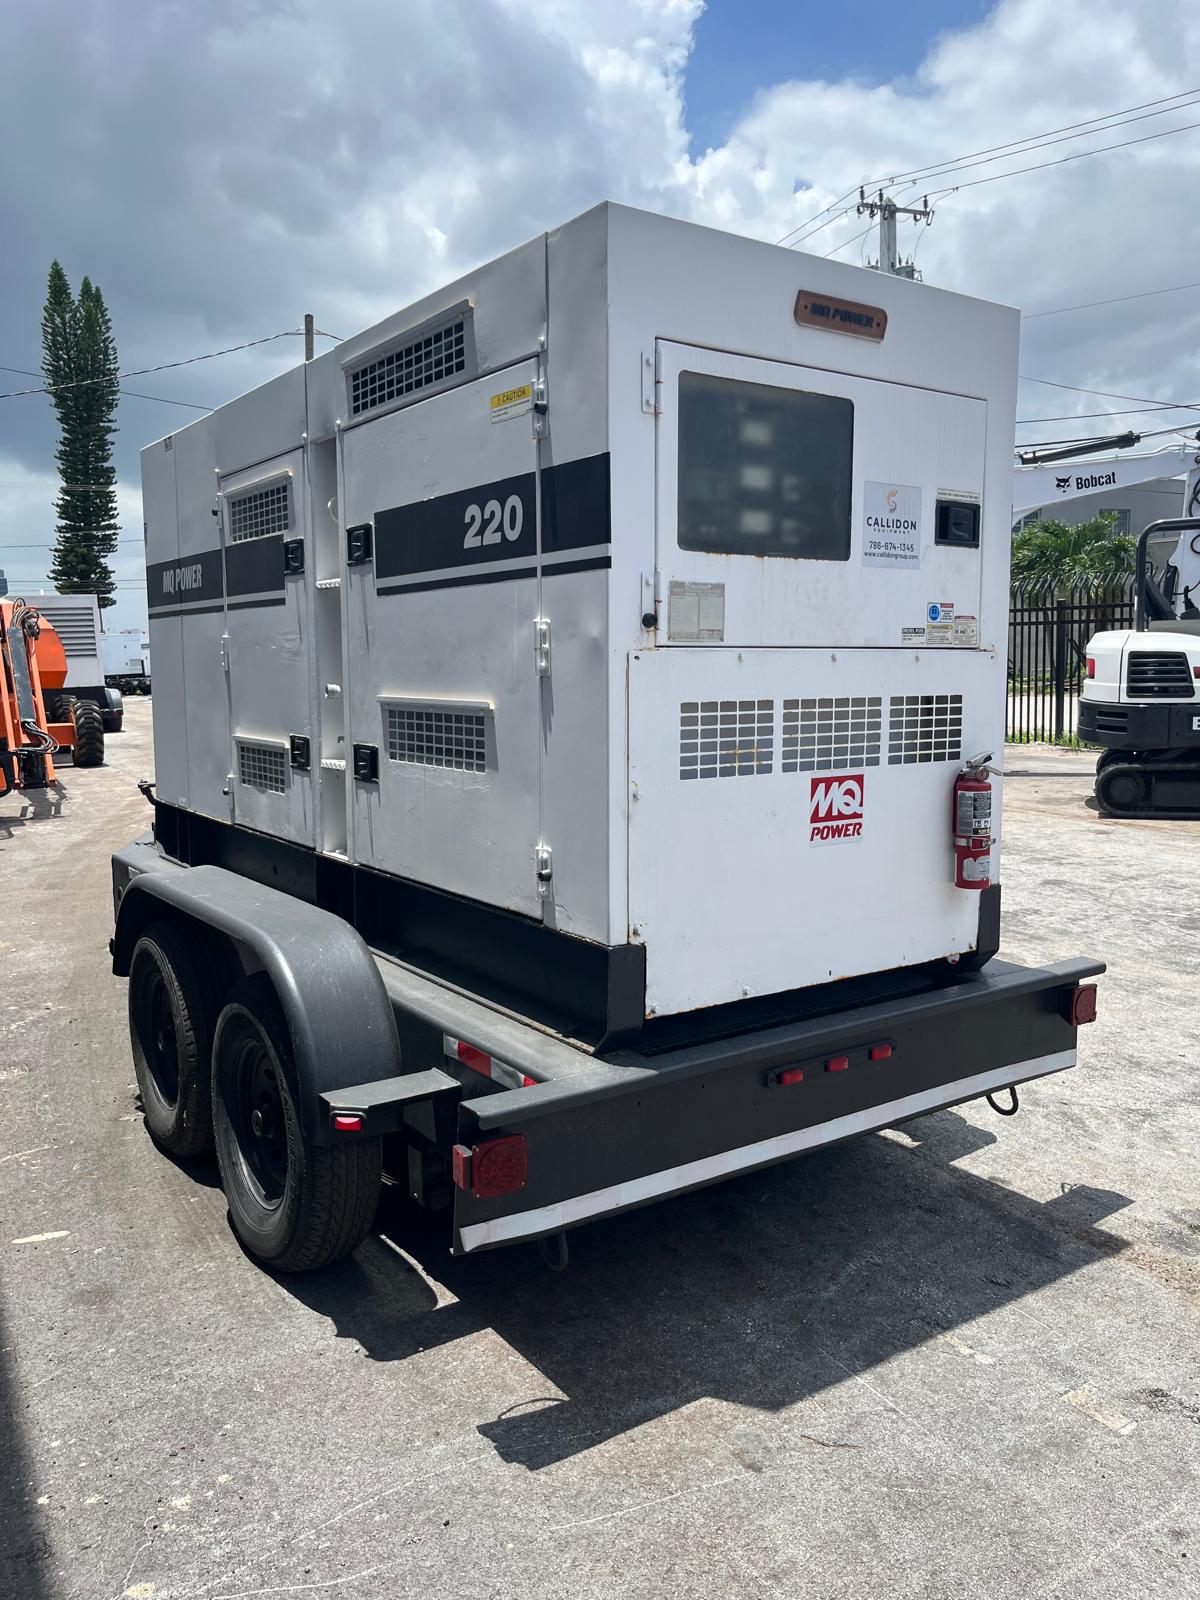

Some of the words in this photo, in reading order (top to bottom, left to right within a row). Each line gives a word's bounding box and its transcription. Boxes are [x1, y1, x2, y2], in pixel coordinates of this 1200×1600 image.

[811, 303, 831, 319] MQ
[832, 308, 874, 328] POWER
[502, 388, 526, 403] CAUTION
[1075, 471, 1117, 490] Bobcat
[463, 494, 524, 549] 220
[866, 516, 917, 531] CALLIDON
[864, 551, 919, 560] www.callidongroup.com
[869, 540, 915, 553] 786-674-1345
[162, 569, 175, 595] MQ
[175, 563, 202, 592] POWER
[810, 779, 863, 818] MQ
[810, 822, 863, 841] POWER
